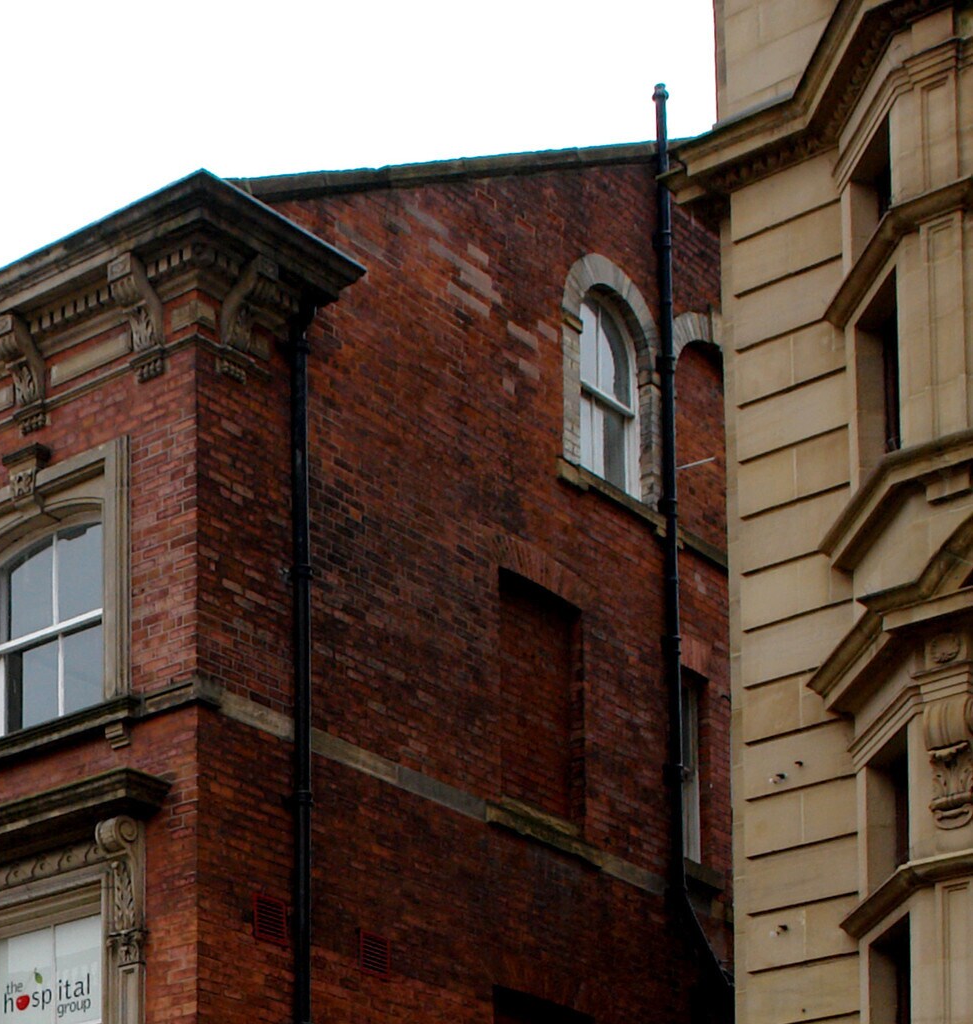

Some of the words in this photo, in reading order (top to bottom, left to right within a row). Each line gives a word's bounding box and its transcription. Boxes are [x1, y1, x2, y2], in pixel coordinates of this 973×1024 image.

[4, 972, 90, 1014] hospital
[6, 981, 23, 995] the
[57, 998, 91, 1018] group
